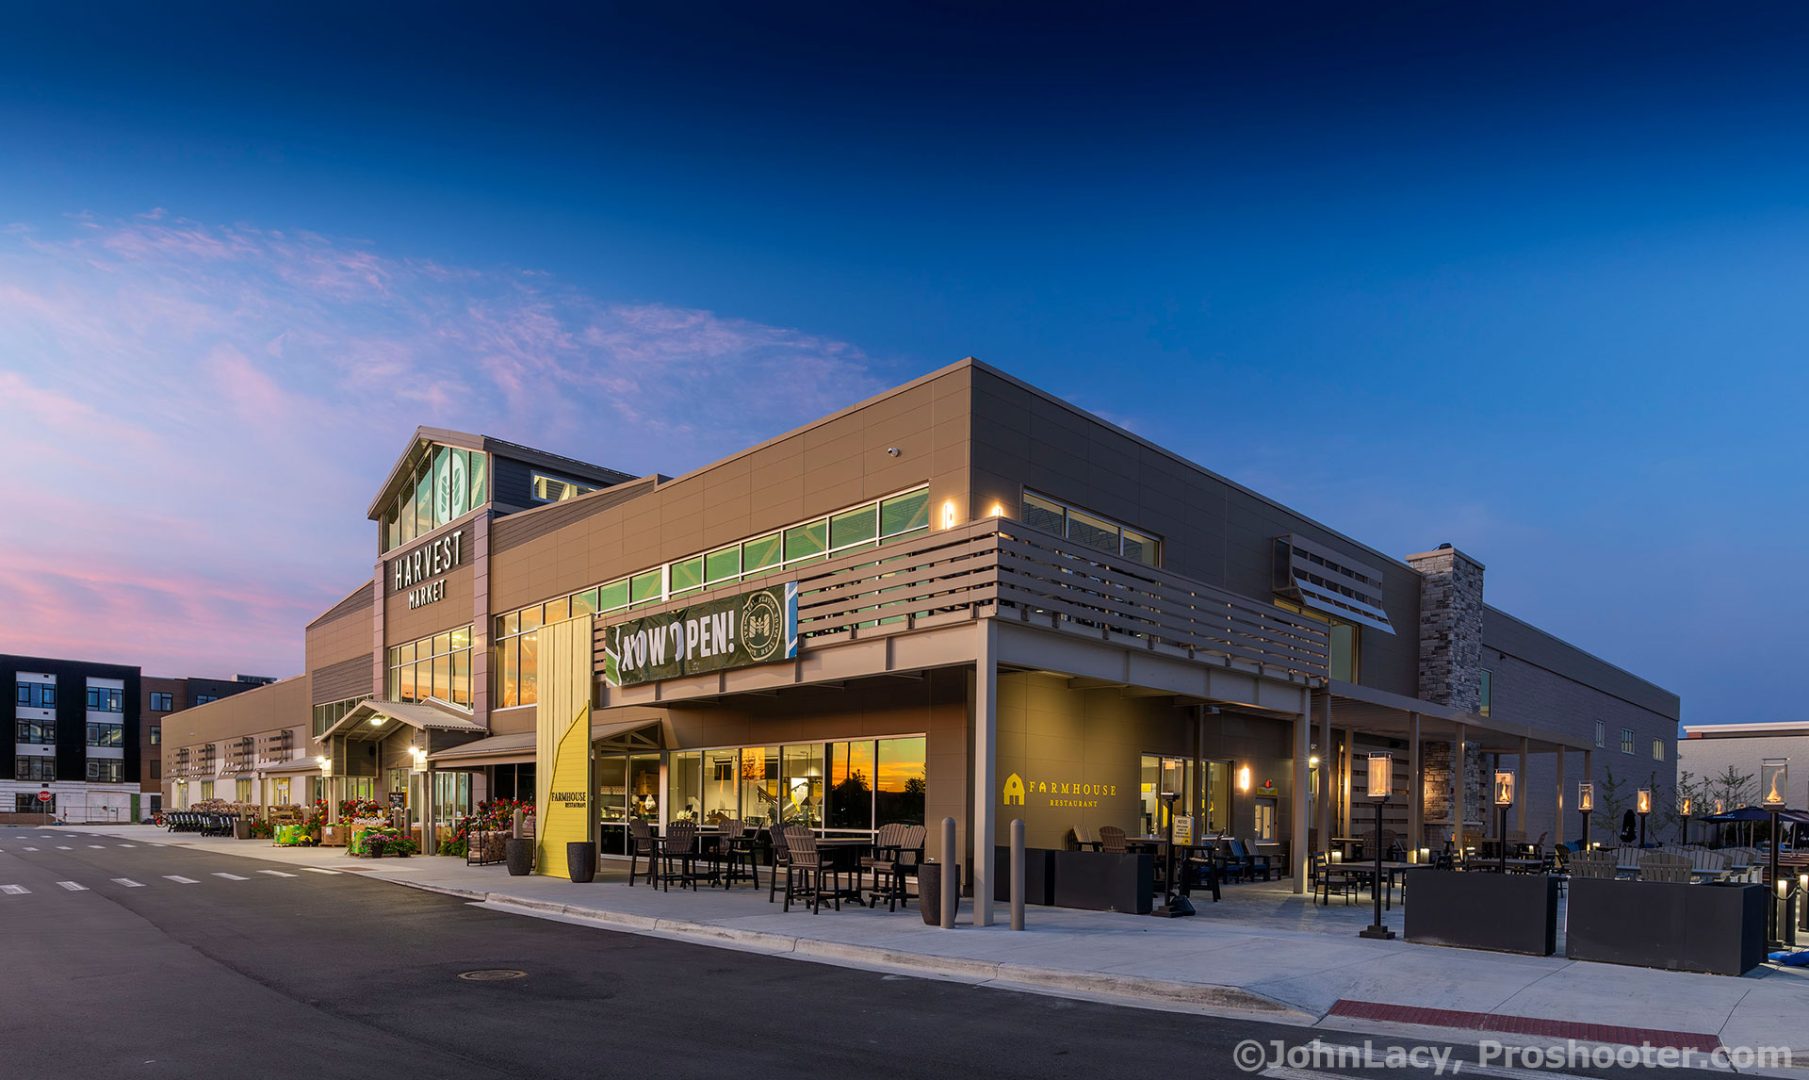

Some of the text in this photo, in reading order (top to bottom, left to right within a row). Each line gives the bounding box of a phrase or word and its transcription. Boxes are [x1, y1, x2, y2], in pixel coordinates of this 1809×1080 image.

[395, 530, 463, 590] HARVEST
[408, 579, 446, 610] MARKET
[621, 610, 735, 672] NOW OPEN!
[551, 791, 586, 802] FARMHOUSE
[1029, 781, 1117, 797] FARMHOUSE
[1049, 799, 1098, 808] RESTAURANT
